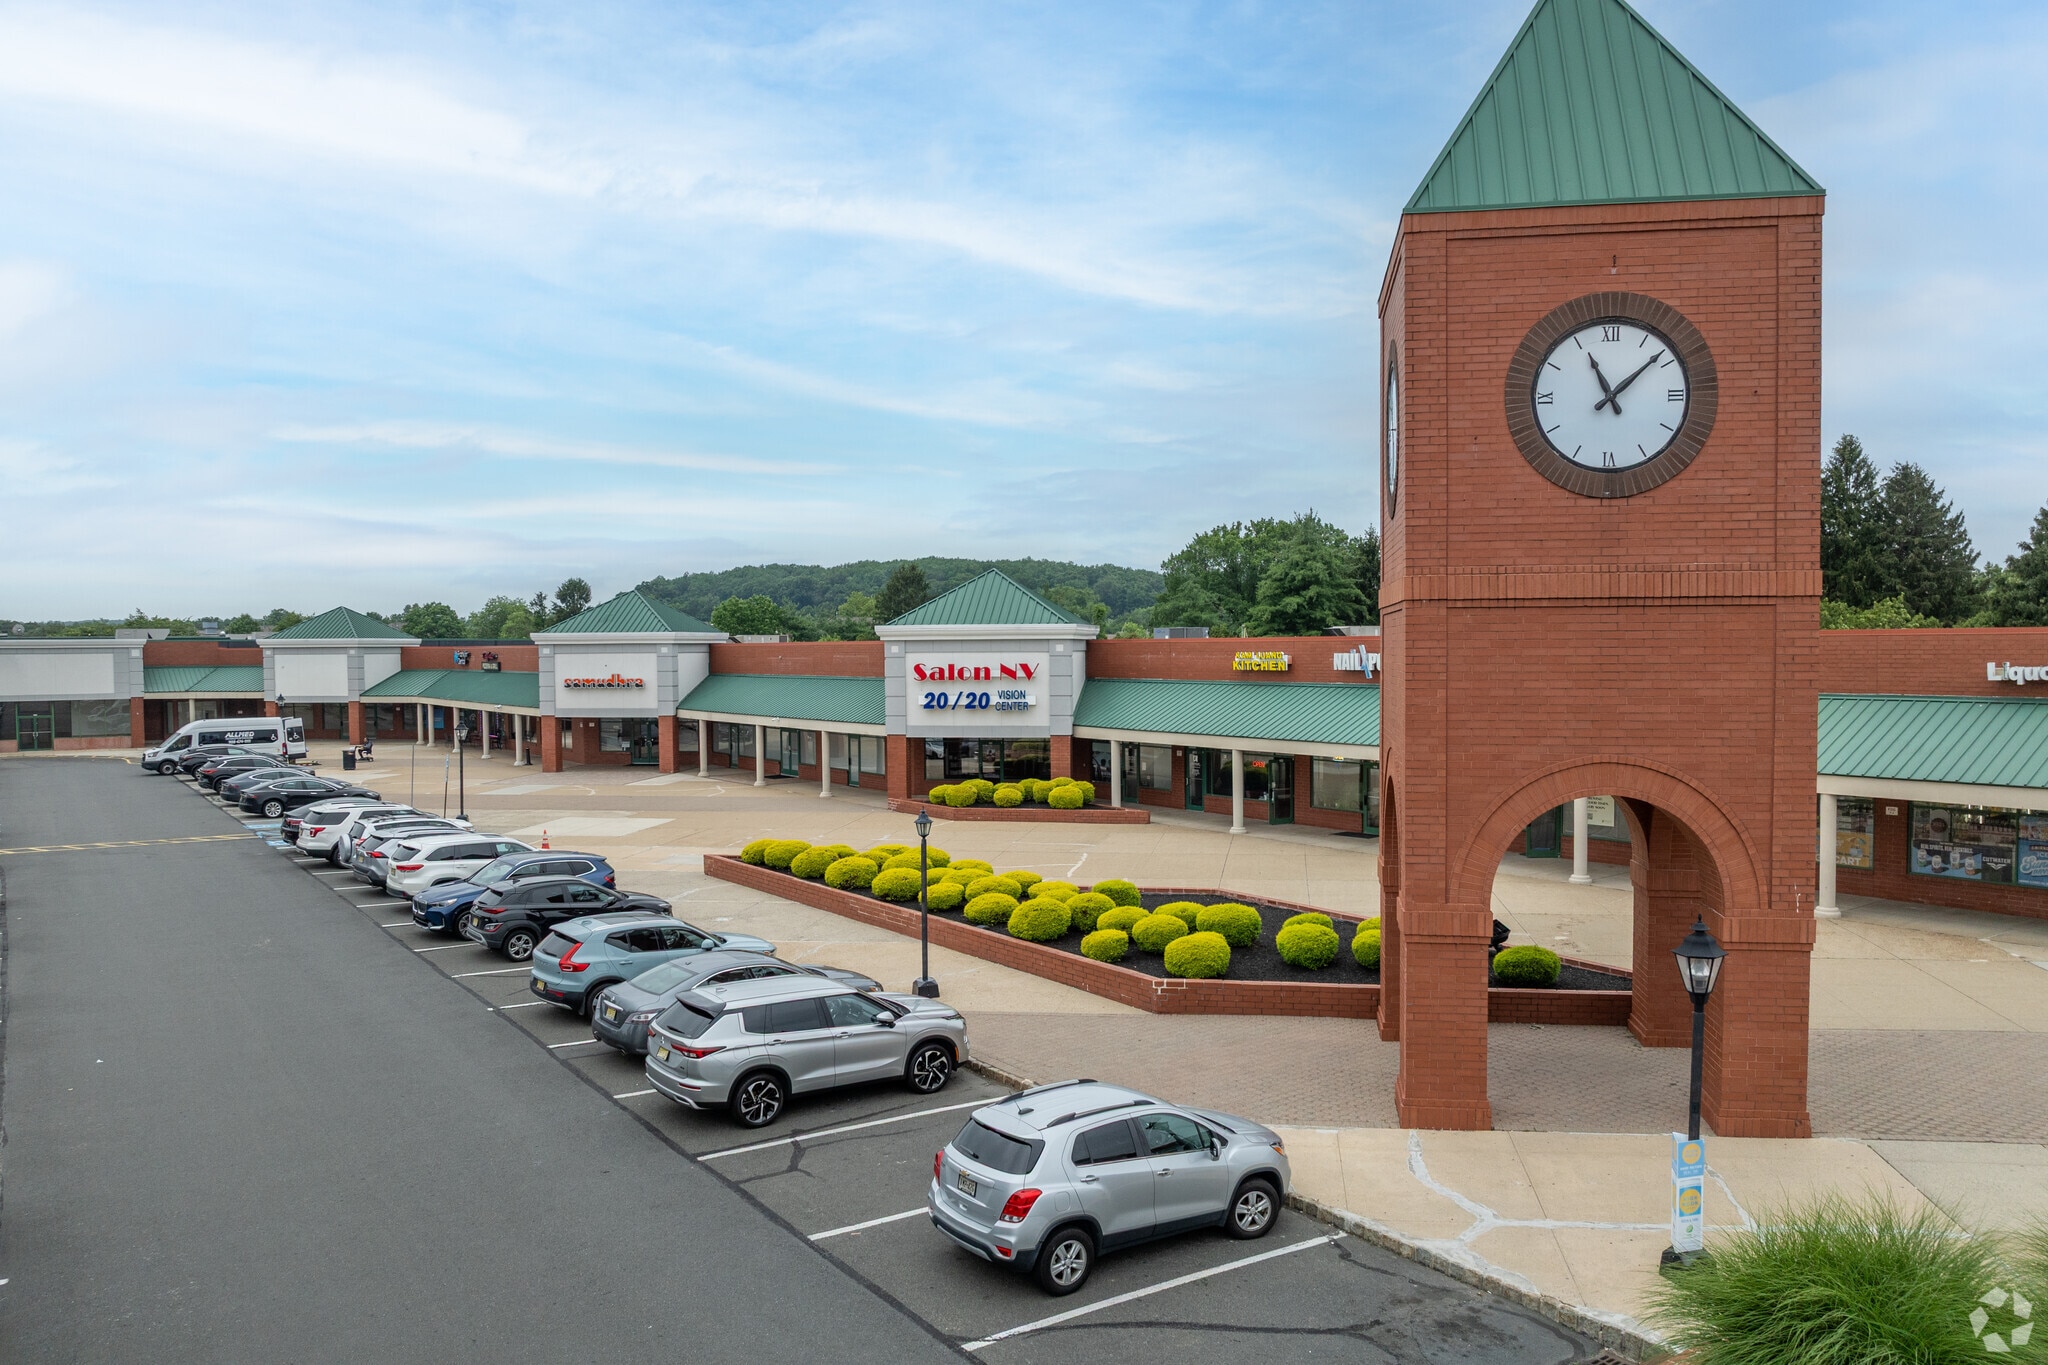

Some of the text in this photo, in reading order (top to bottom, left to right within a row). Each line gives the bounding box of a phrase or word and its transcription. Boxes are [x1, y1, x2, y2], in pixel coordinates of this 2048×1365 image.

[1232, 660, 1286, 671] KITCHEN
[913, 663, 1039, 681] Salon NV
[563, 674, 643, 688] samudhra
[923, 691, 991, 710] 20/20
[998, 690, 1026, 700] VISION
[994, 701, 1030, 711] CENTER
